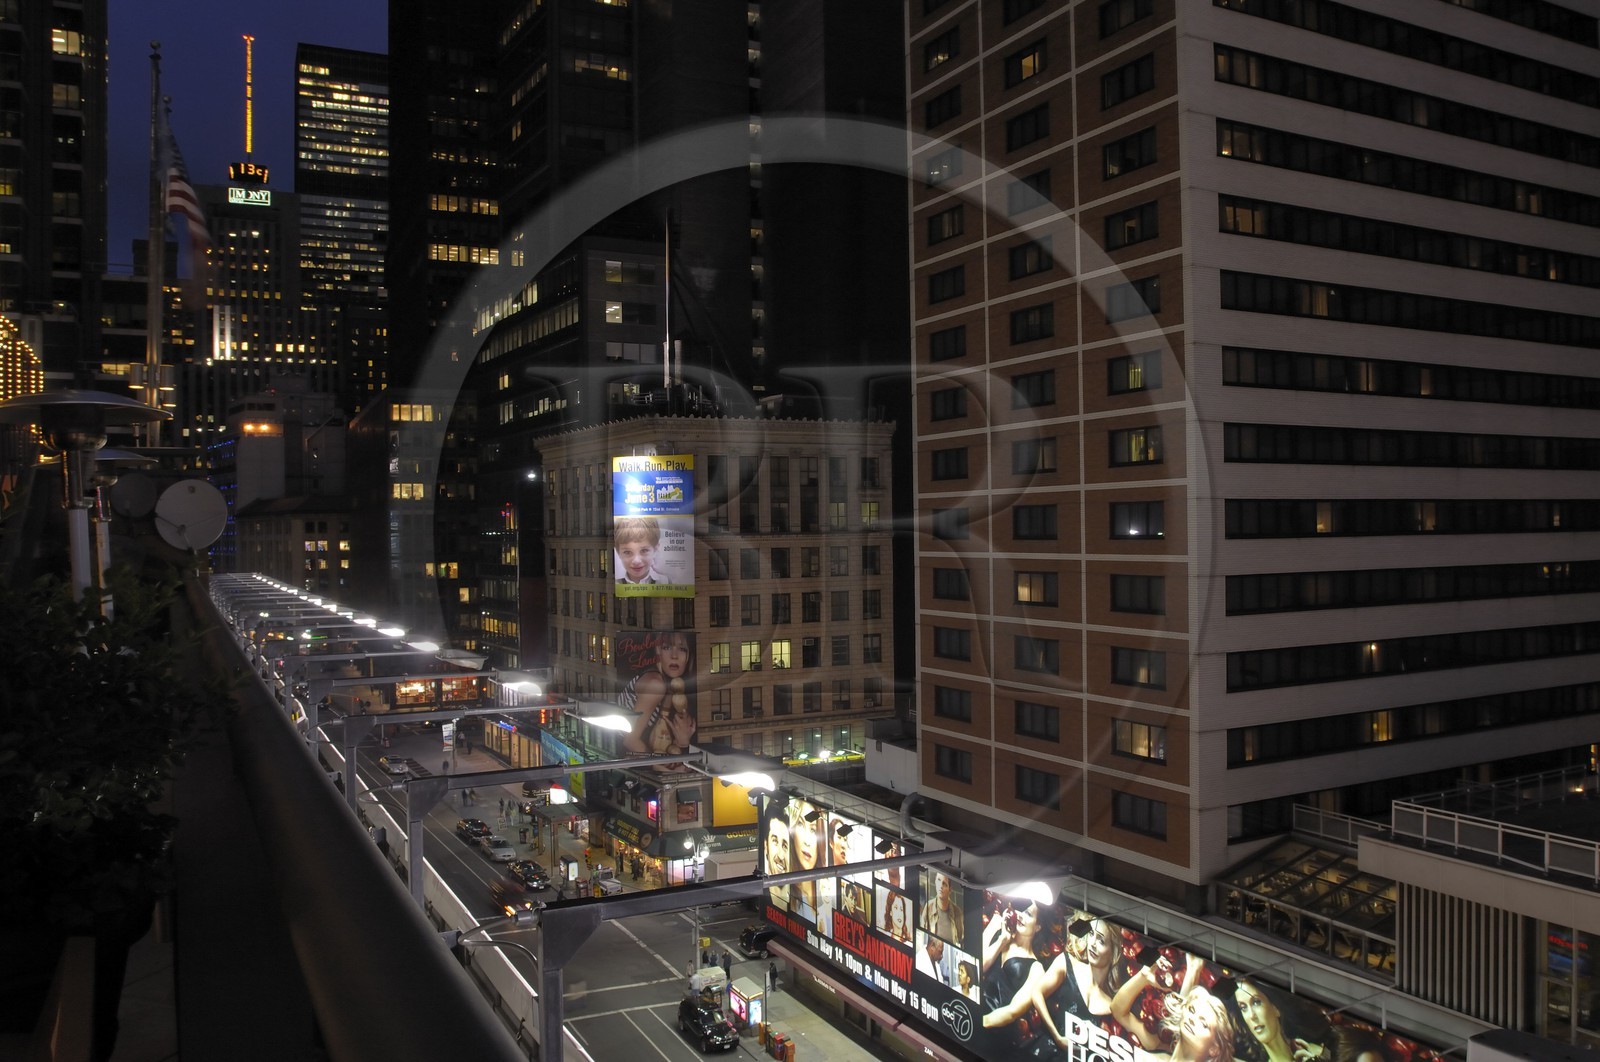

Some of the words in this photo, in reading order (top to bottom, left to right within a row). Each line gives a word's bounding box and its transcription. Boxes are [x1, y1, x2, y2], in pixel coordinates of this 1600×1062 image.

[618, 461, 644, 472] Walk.
[644, 461, 665, 472] Run.
[666, 460, 688, 472] Play.
[625, 483, 655, 493] Srday
[624, 493, 648, 504] June
[649, 492, 655, 504] 3
[663, 544, 686, 552] abilities.
[726, 829, 759, 839] GOURME
[834, 911, 865, 953] GREY'S
[865, 937, 913, 985] ANATOMY
[766, 905, 787, 928] SEASON
[788, 918, 806, 940] FINALE
[806, 930, 819, 949] Sun
[820, 938, 833, 960] May
[834, 947, 843, 964] 14
[845, 952, 863, 976] 10pm
[864, 964, 873, 981] &
[874, 969, 889, 992] Mon
[891, 979, 907, 1005] May
[909, 991, 919, 1010] 15
[921, 997, 939, 1022] 9pm
[941, 1007, 955, 1021] abc
[1064, 1010, 1146, 1062] DES
